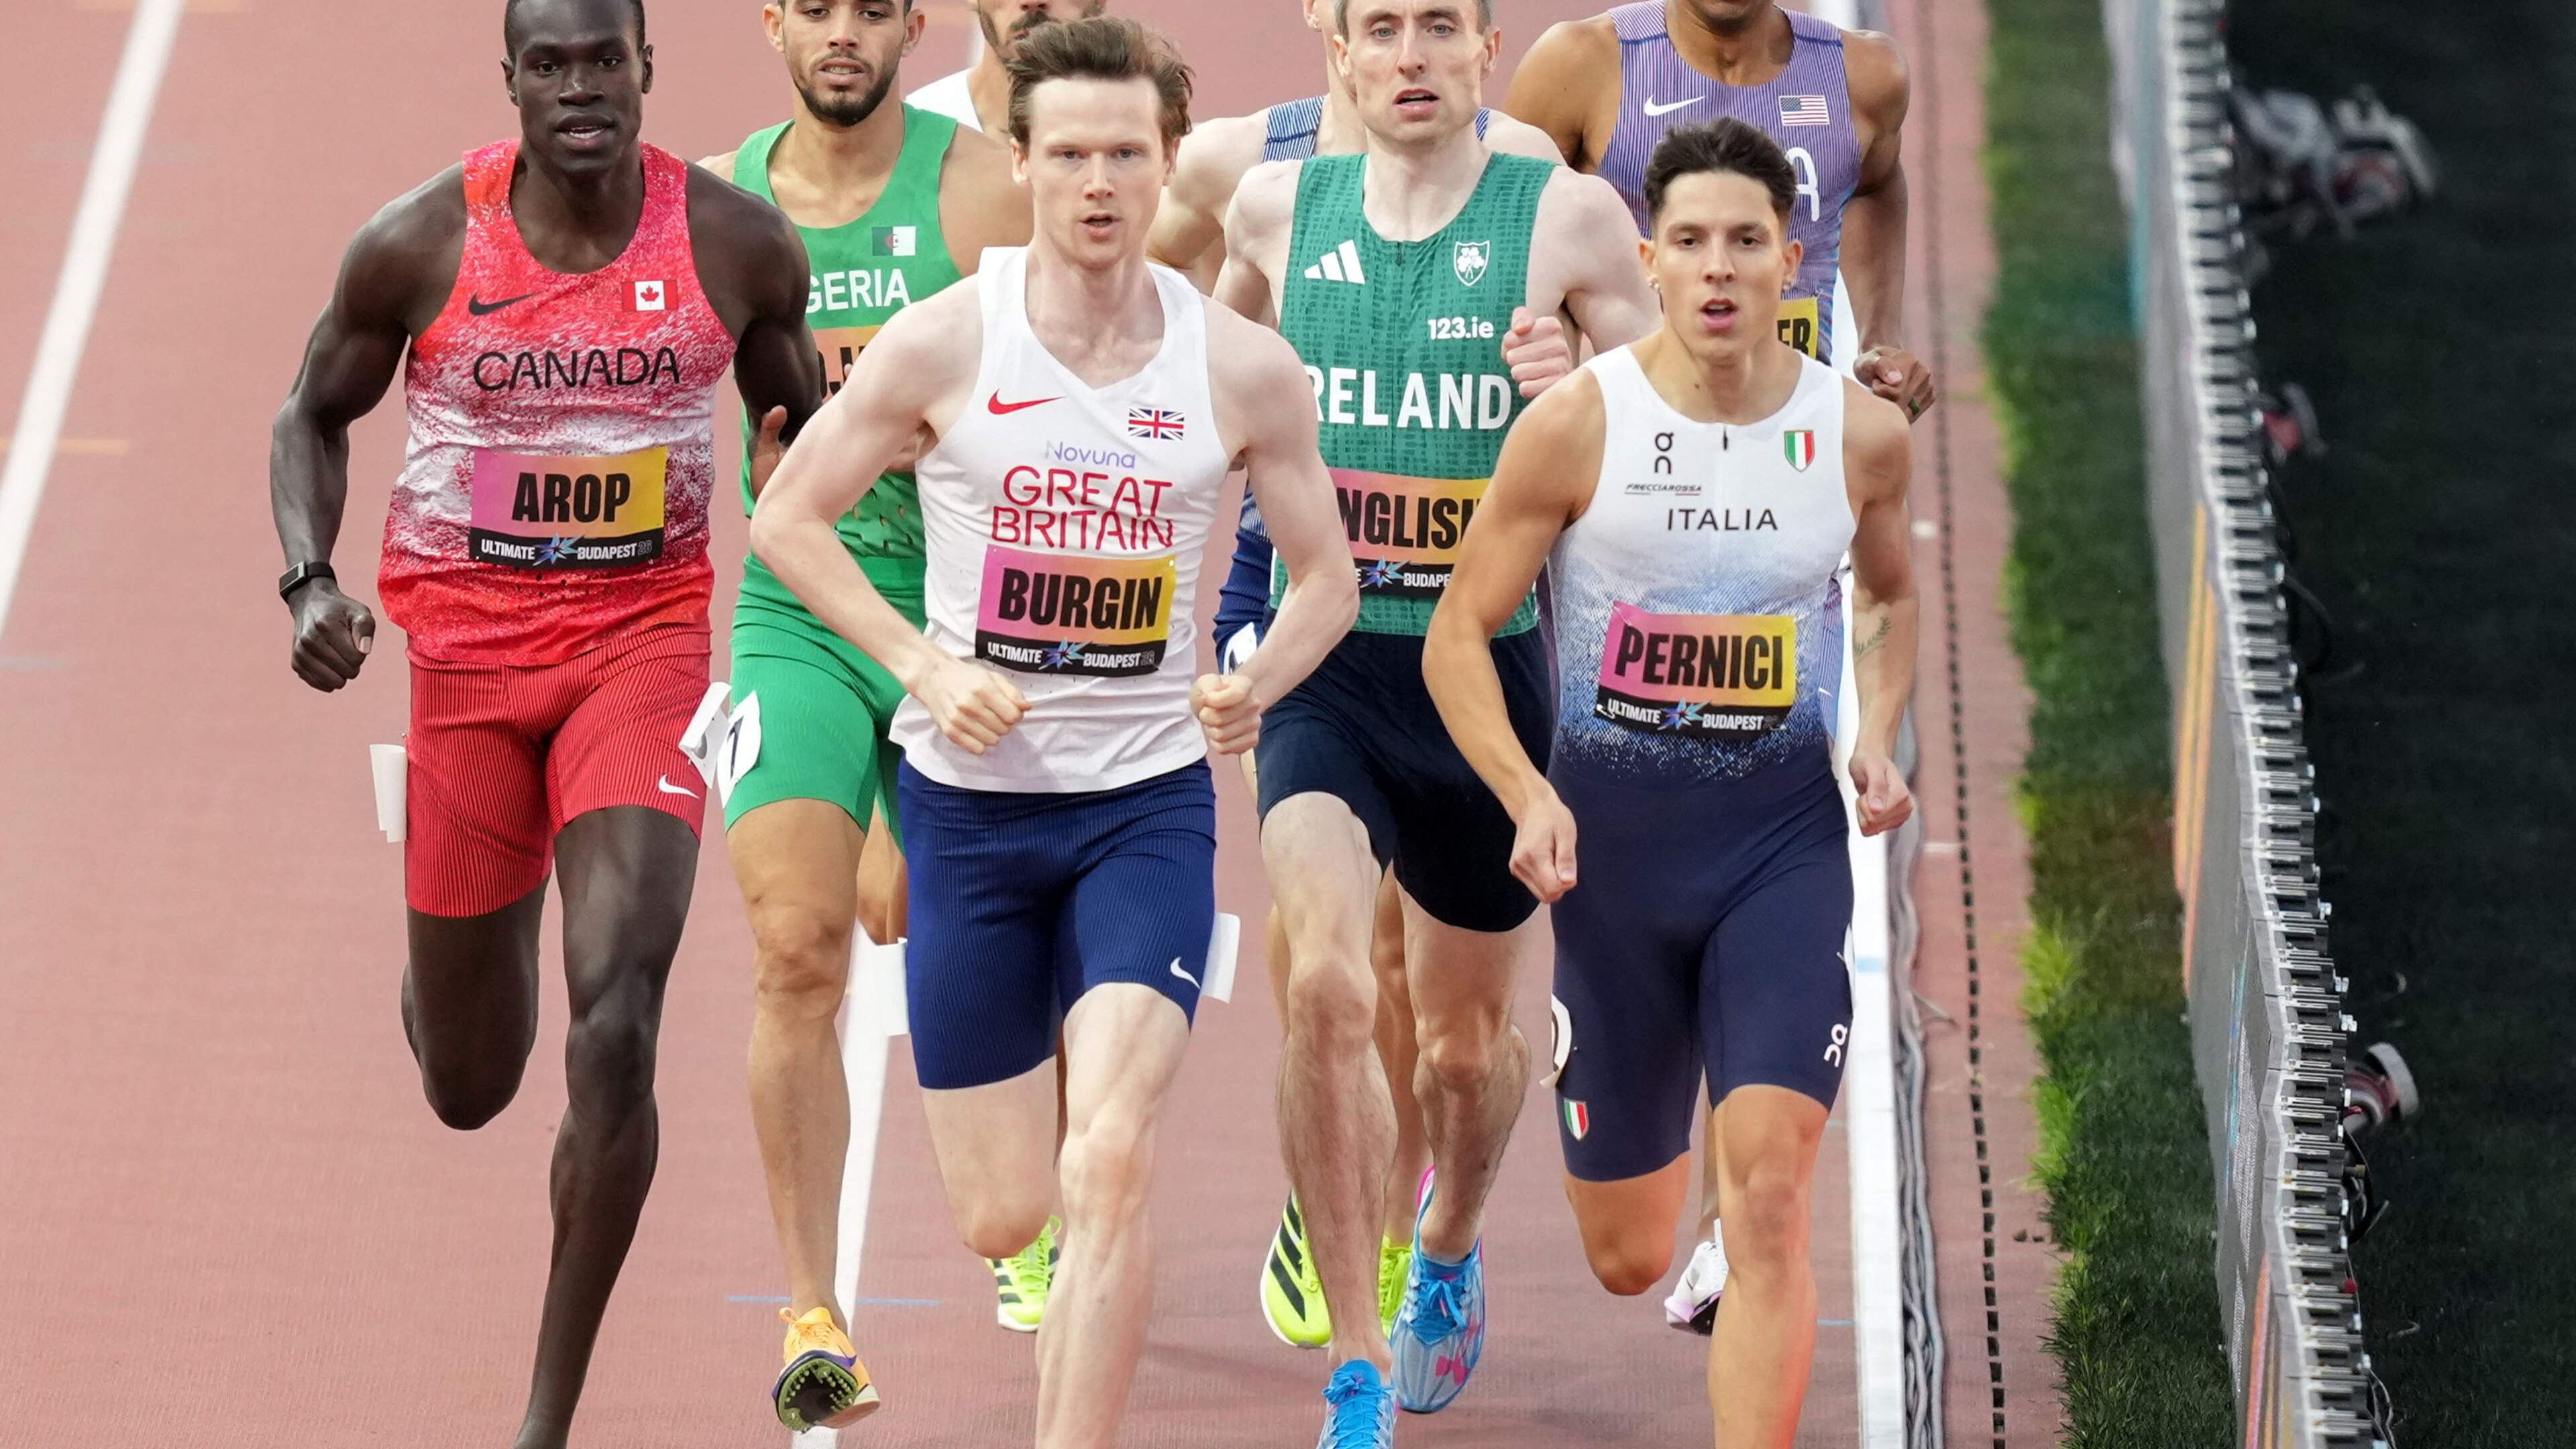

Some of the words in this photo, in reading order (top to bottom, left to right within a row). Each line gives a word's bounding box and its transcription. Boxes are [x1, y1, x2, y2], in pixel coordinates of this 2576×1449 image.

[805, 268, 911, 313] GERIA
[1428, 316, 1495, 340] 123.ie
[473, 347, 680, 391] CANADA
[1304, 364, 1512, 430] RELAND
[1045, 441, 1136, 469] Novuna
[511, 472, 631, 523] AROP
[1003, 466, 1173, 517] GREAT
[991, 506, 1175, 550] BRITAIN
[1336, 487, 1481, 550] NGLIS
[1668, 508, 1778, 531] ITALIA
[481, 539, 535, 559] ULTIMATE
[998, 567, 1163, 630] BURGIN
[1403, 572, 1451, 588] BUDAPE
[987, 641, 1042, 664] ULTIMATE
[1613, 620, 1784, 690] PERNICI
[1607, 698, 1661, 724] ULTIMATE
